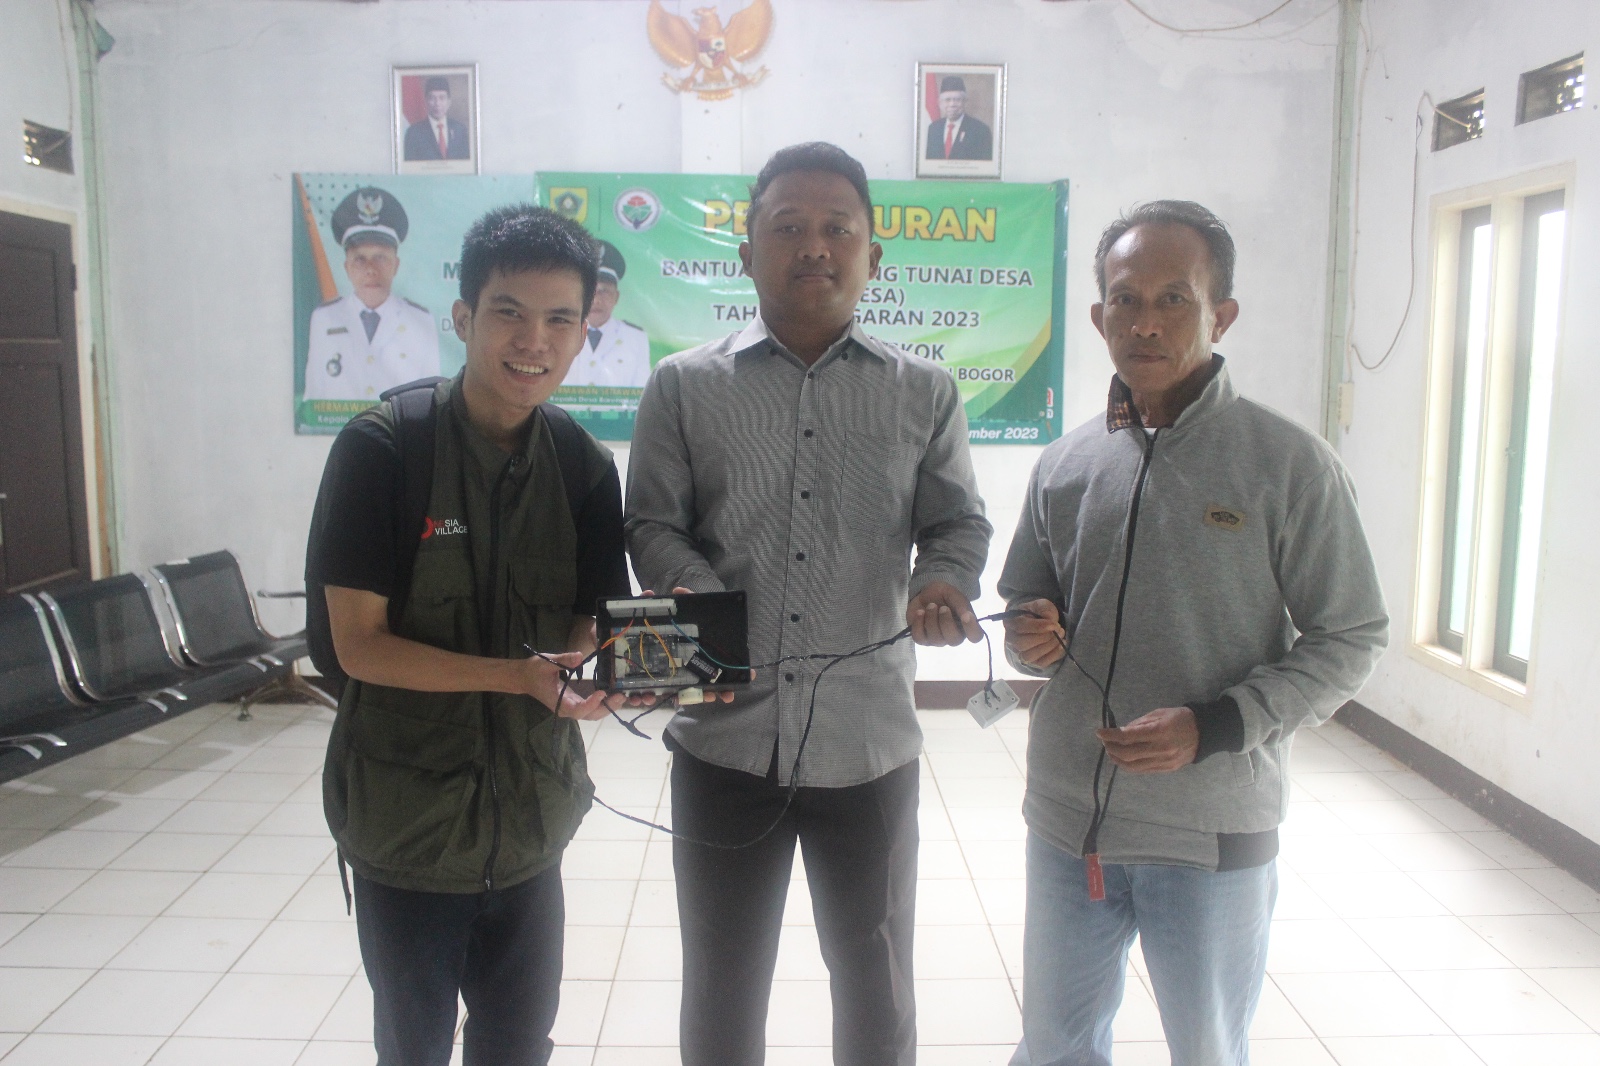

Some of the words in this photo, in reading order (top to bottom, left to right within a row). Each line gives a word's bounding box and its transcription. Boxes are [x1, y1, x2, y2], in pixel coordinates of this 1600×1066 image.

[905, 266, 973, 284] TUNAI
[980, 269, 1033, 286] DESA
[860, 287, 905, 307] ESA)
[713, 304, 757, 321] TAH
[931, 310, 980, 327] 2023
[958, 367, 1014, 382] BOGOR
[968, 427, 1002, 439] mber
[1004, 427, 1039, 439] 2023
[434, 526, 468, 535] VILLAGE
